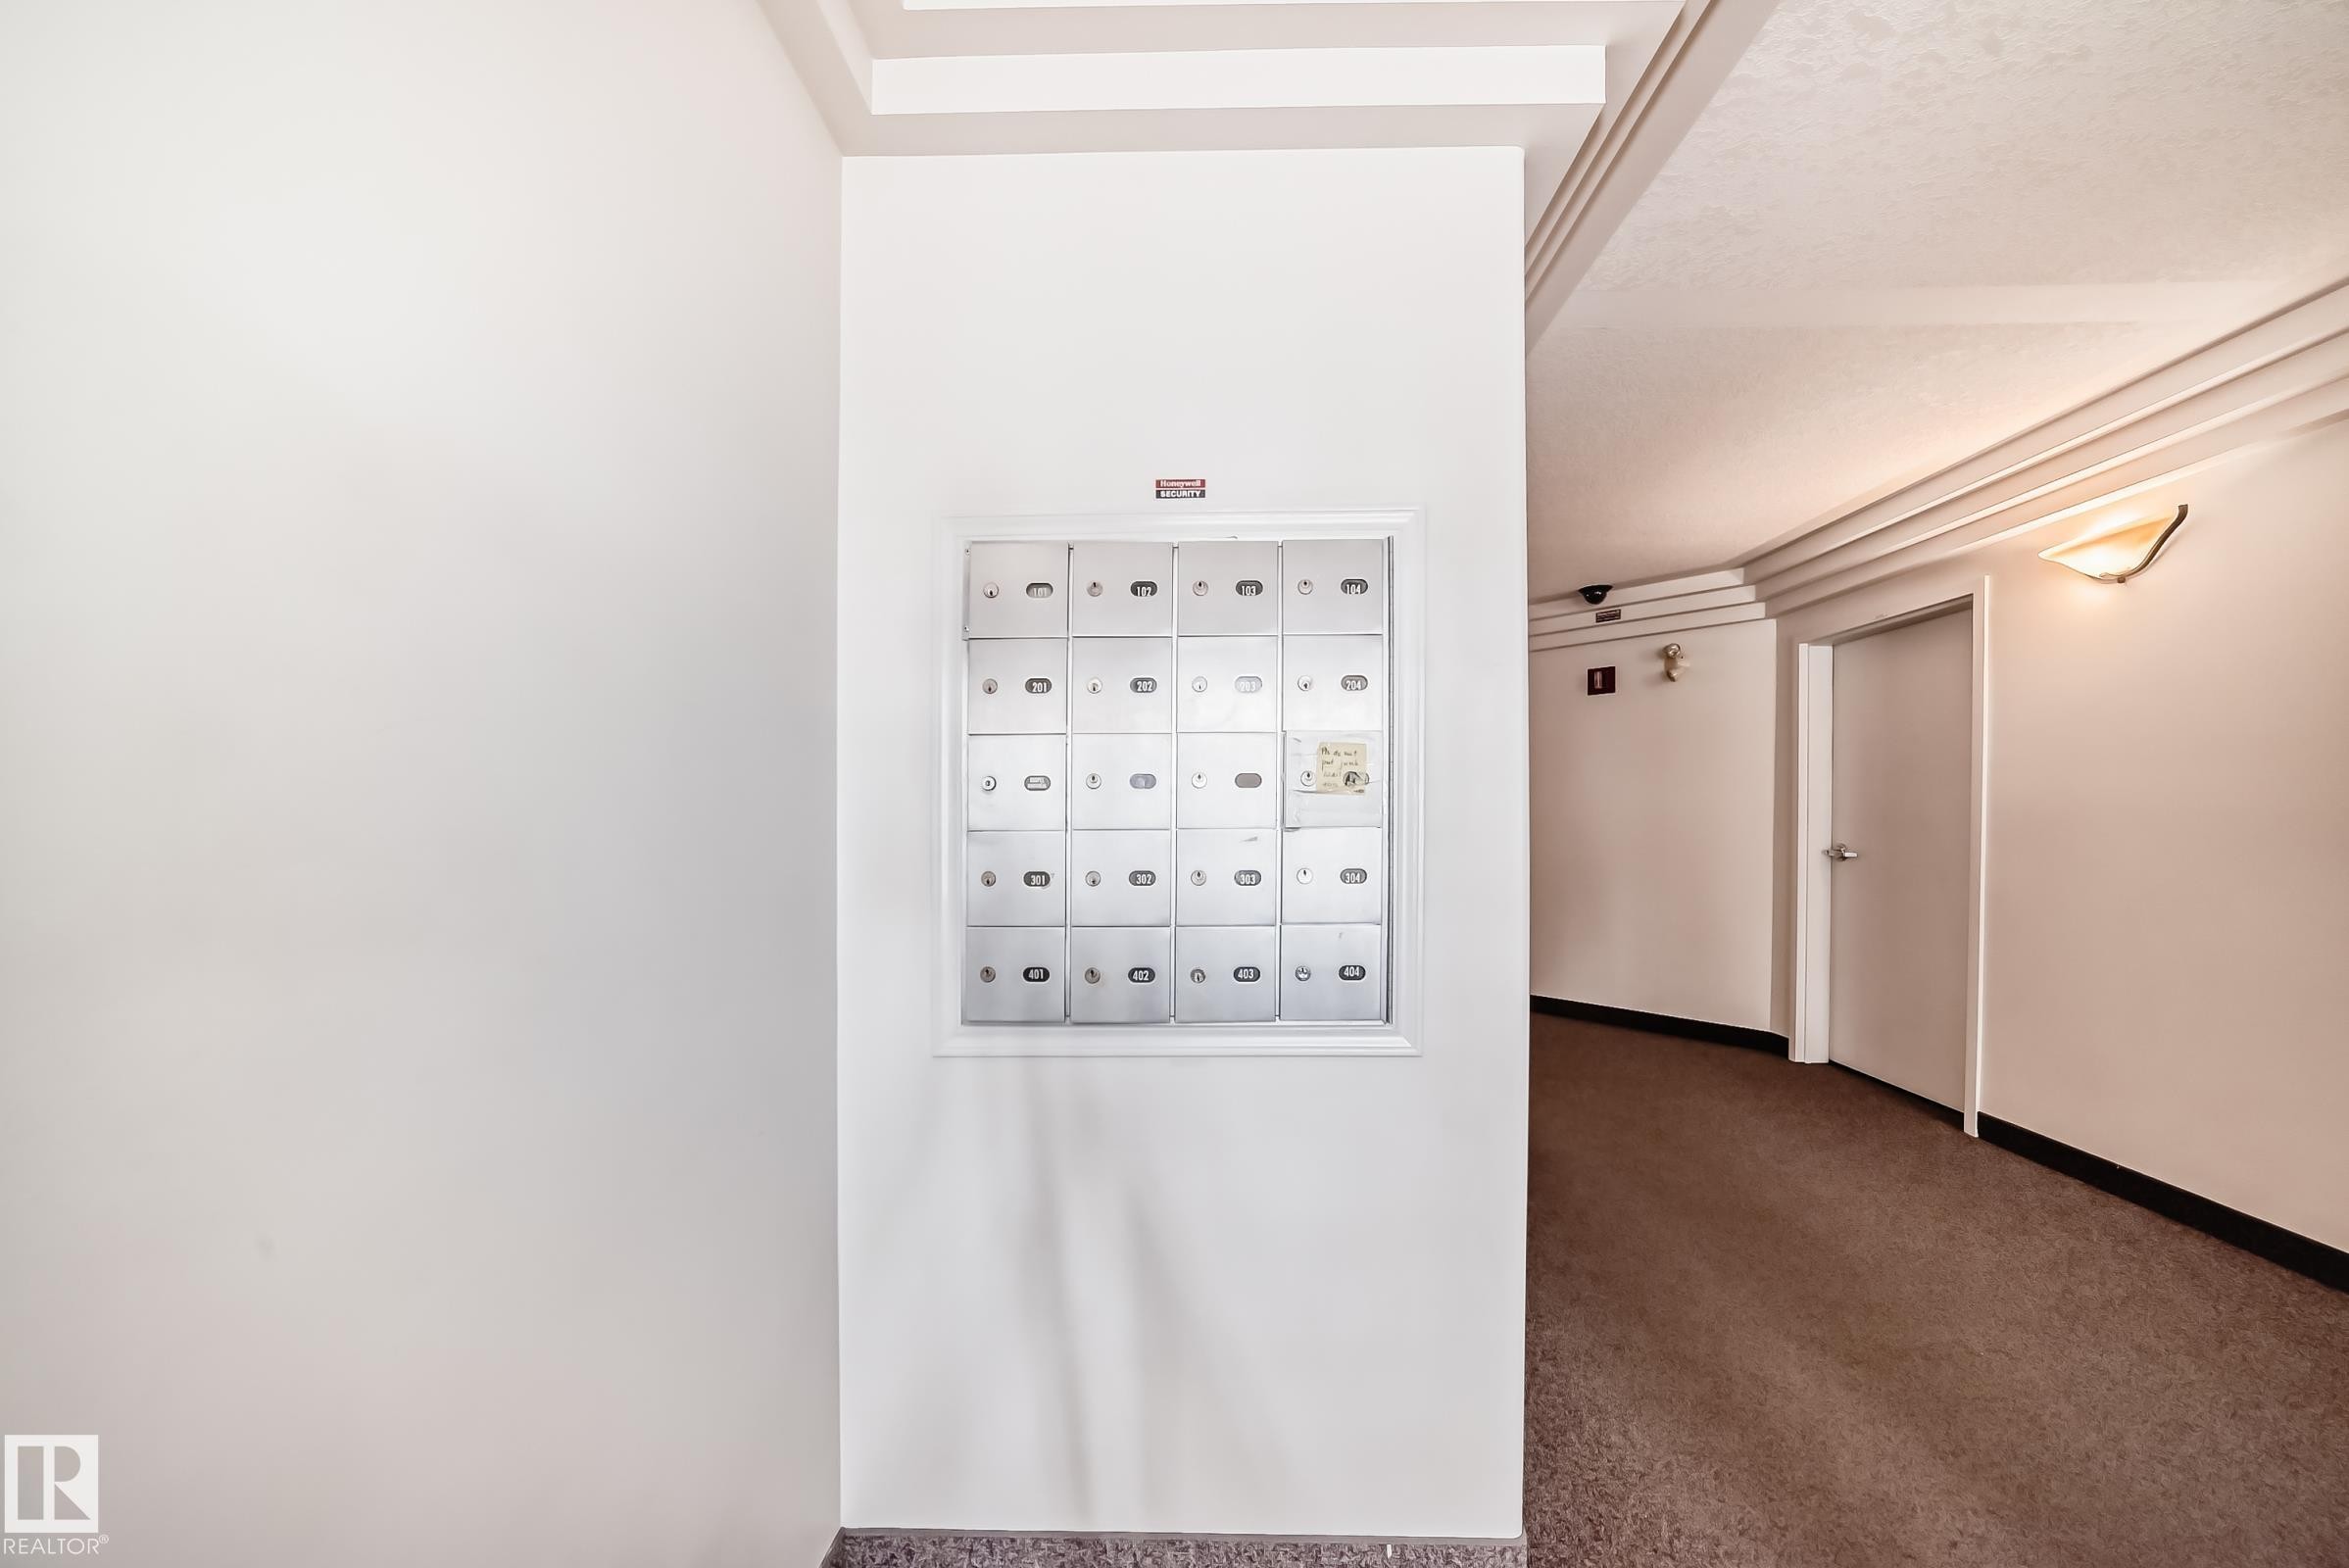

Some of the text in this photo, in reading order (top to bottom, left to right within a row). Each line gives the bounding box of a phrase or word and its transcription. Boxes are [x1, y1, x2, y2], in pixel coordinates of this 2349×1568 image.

[1160, 479, 1201, 488] Honeywell
[1033, 587, 1048, 597] 101
[1136, 586, 1151, 597] 102
[1242, 585, 1256, 596] 103
[1346, 584, 1361, 595] 104
[1032, 682, 1048, 693] 201
[1137, 681, 1152, 692] 202
[1240, 681, 1255, 692] 203
[1346, 680, 1361, 691] 204
[1030, 875, 1046, 886] 301
[1136, 874, 1151, 885] 302
[1240, 874, 1255, 885] 303
[1345, 873, 1360, 883] 304
[1028, 968, 1044, 980] 401
[1133, 970, 1149, 981] 402
[1237, 968, 1254, 979] 403
[1344, 967, 1359, 977] 404
